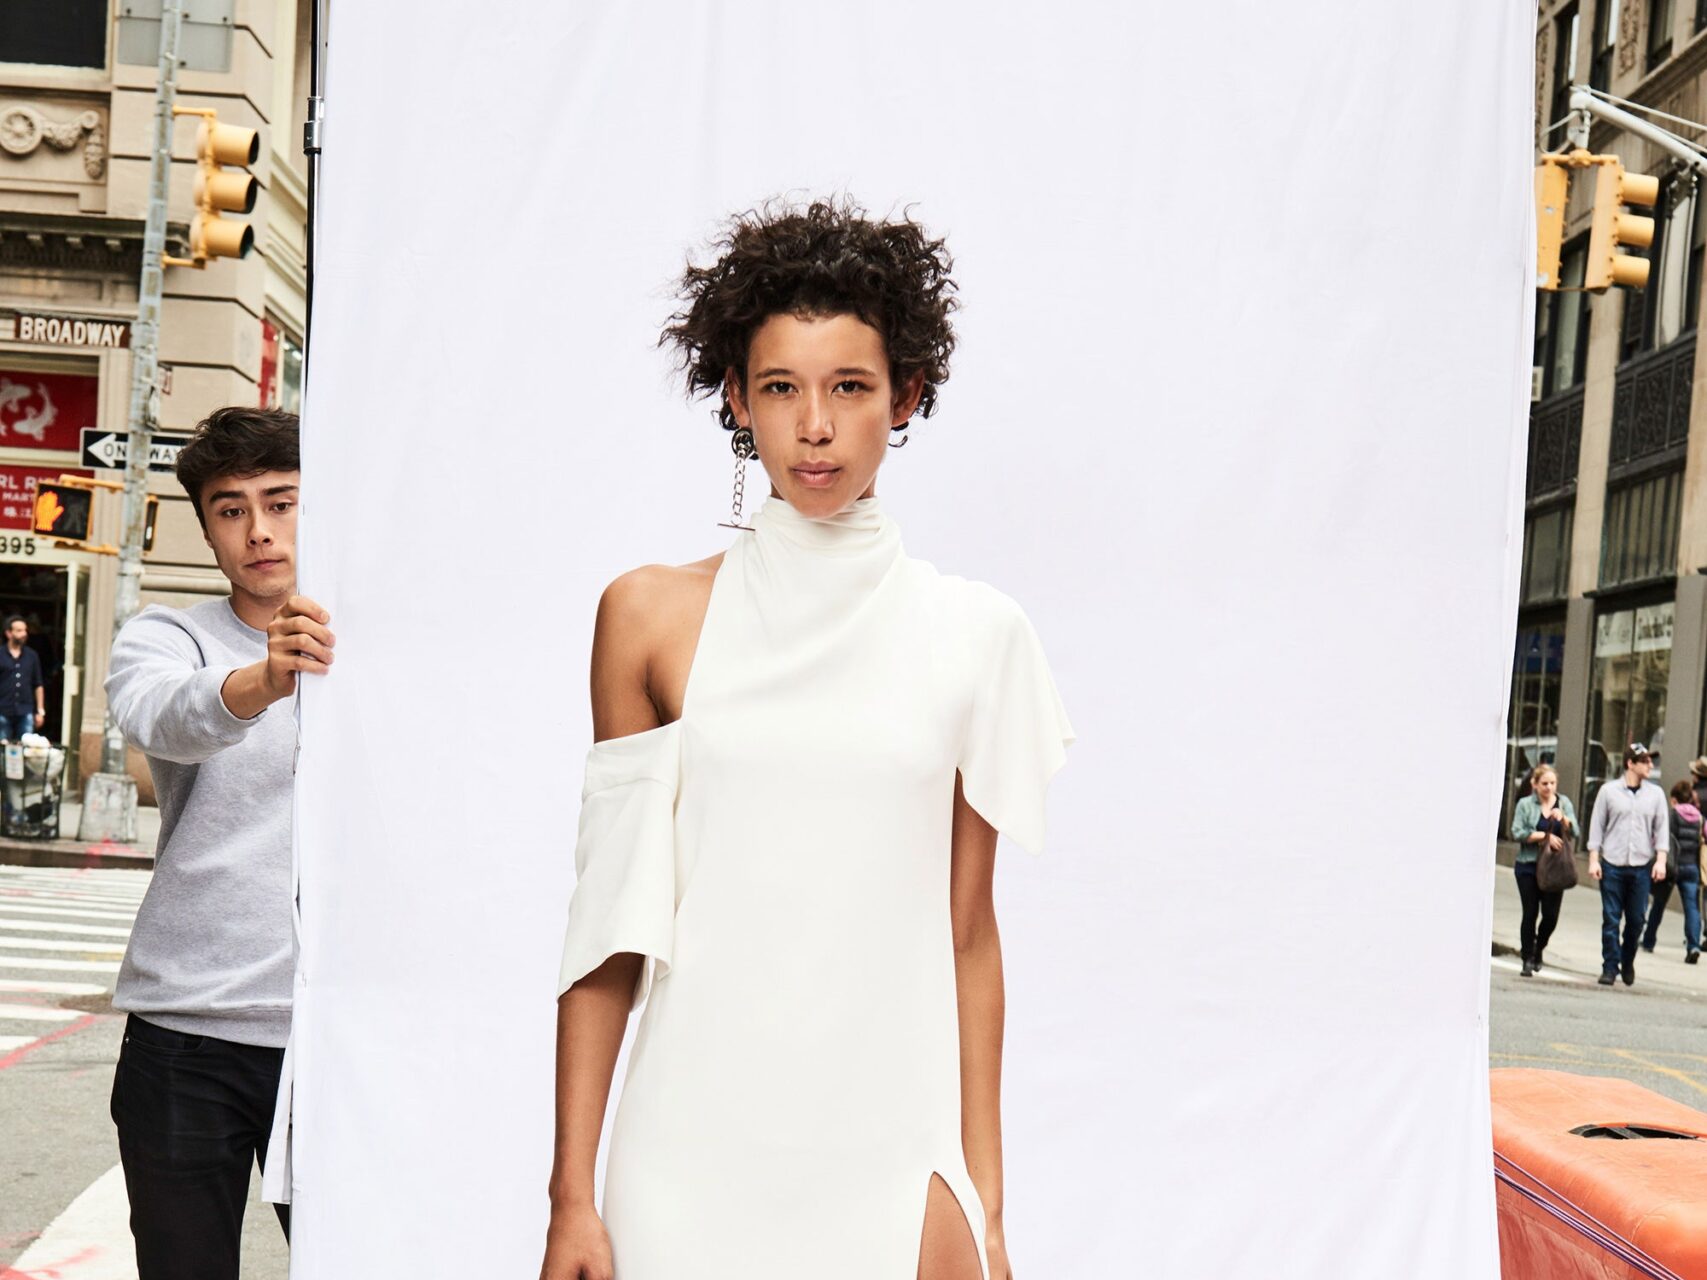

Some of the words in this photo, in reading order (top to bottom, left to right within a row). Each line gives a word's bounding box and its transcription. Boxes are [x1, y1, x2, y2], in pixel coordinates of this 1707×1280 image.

[20, 316, 125, 347] BROADWAY
[104, 443, 127, 457] ON
[149, 447, 178, 461] WA
